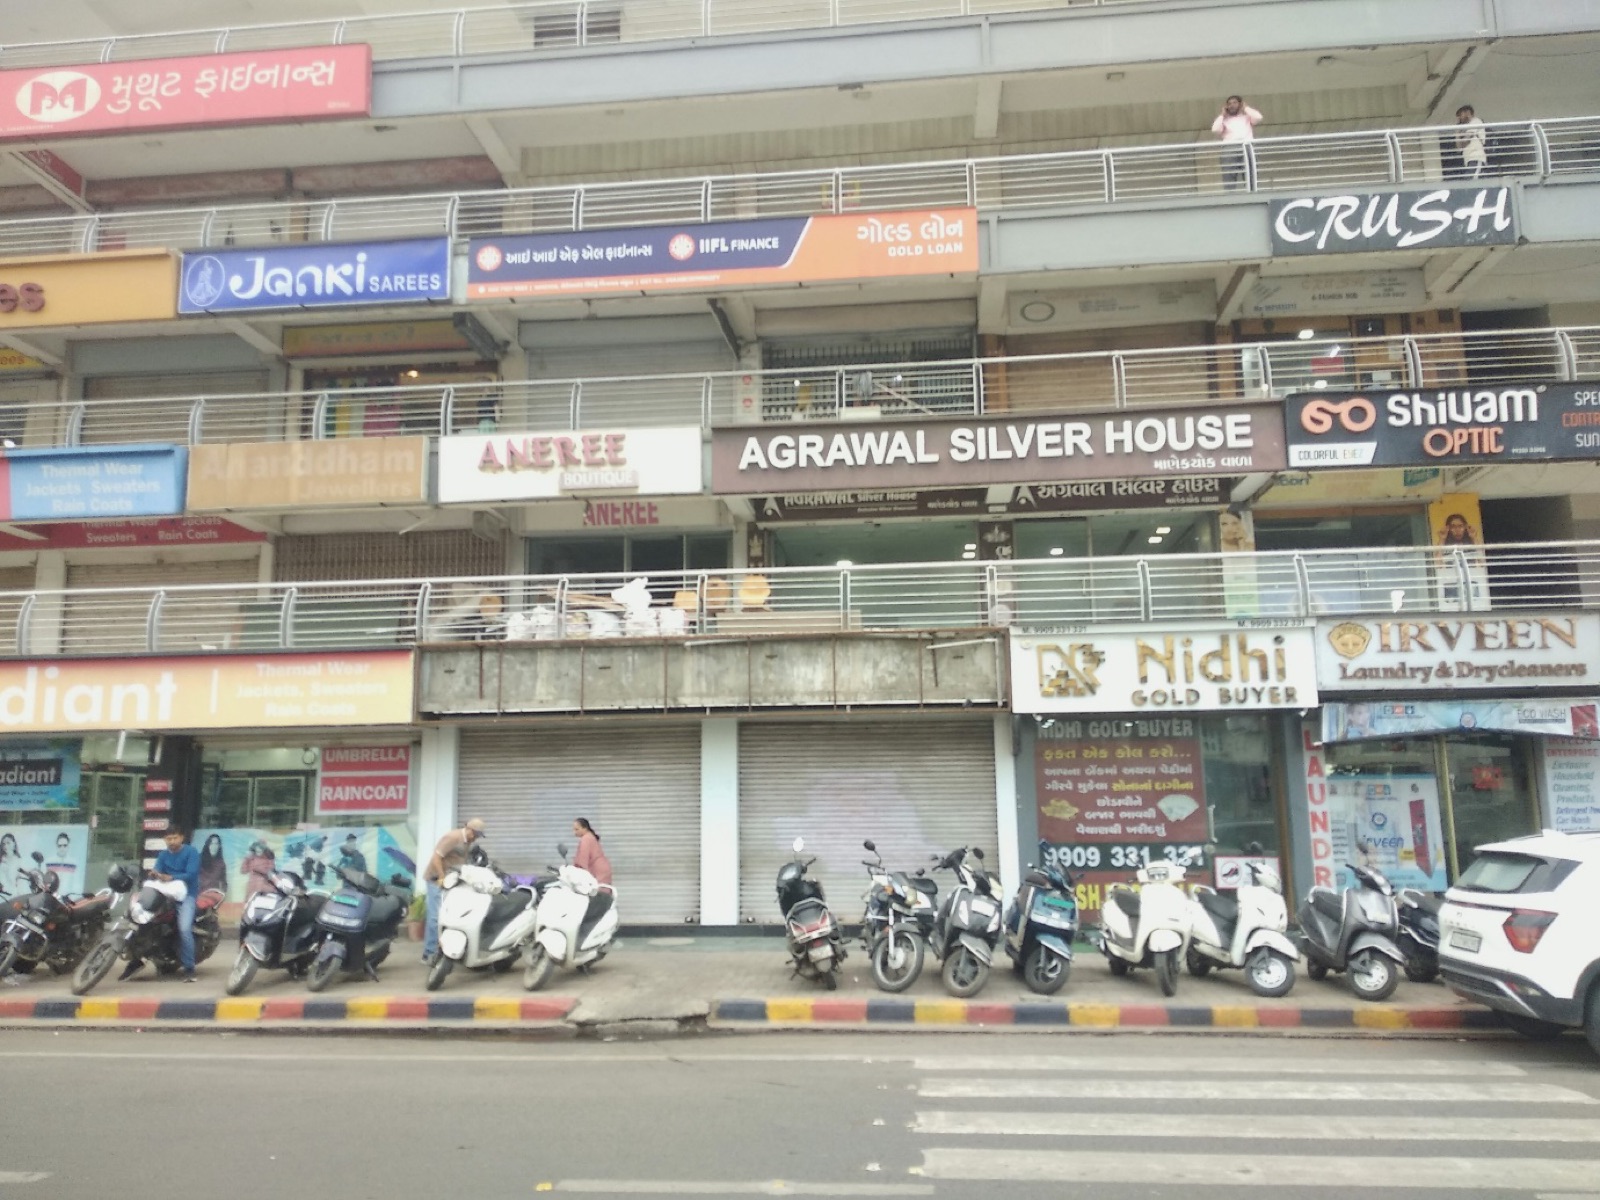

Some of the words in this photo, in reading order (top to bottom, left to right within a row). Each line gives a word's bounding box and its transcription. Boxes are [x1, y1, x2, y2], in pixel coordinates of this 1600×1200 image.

[106, 71, 182, 115] મુથૂટ
[856, 217, 912, 243] ગોલ્ડ
[920, 213, 964, 239] લોન
[1274, 187, 1511, 249] CRUSH
[699, 236, 729, 254] IIFL
[731, 236, 780, 252] FINANCE
[888, 242, 924, 257] GOLD
[927, 241, 964, 255] LOAN
[228, 251, 368, 300] Janki
[369, 273, 441, 293] SAREES
[738, 428, 940, 471] AGRAWAL
[949, 422, 1094, 462] SILVER
[1105, 413, 1255, 454] HOUSE
[1423, 426, 1505, 457] OPTIC
[478, 433, 627, 474] ANEREE
[1298, 449, 1339, 461] COLORFUL
[41, 463, 100, 478] Thermal
[104, 461, 144, 476] Wear
[563, 471, 633, 486] BOUTIQUE
[26, 482, 82, 497] Jackets
[90, 479, 161, 495] Sweaters
[52, 499, 86, 512] Rain
[90, 497, 134, 512] Coats
[86, 532, 137, 544] Sweaters
[158, 530, 183, 541] Rain
[186, 528, 218, 540] Coats
[1375, 616, 1580, 653] IRVEEN
[1135, 632, 1286, 685] Nidhi
[256, 661, 322, 678] Thermal
[327, 660, 370, 676] Wear
[1338, 661, 1434, 684] Laundry
[0, 666, 178, 725] diant
[309, 681, 388, 697] Sweaters
[1131, 688, 1201, 706] GOLD
[1217, 686, 1298, 705] BUYER
[265, 702, 302, 718] Rain
[306, 700, 357, 716] Coats
[1037, 720, 1082, 739] NIDHI
[1088, 720, 1132, 738] GOLD
[1138, 719, 1194, 737] BUYER
[324, 746, 407, 763] UMBRELLA
[321, 784, 408, 802] RAINCOAT
[1045, 846, 1101, 868] 9909
